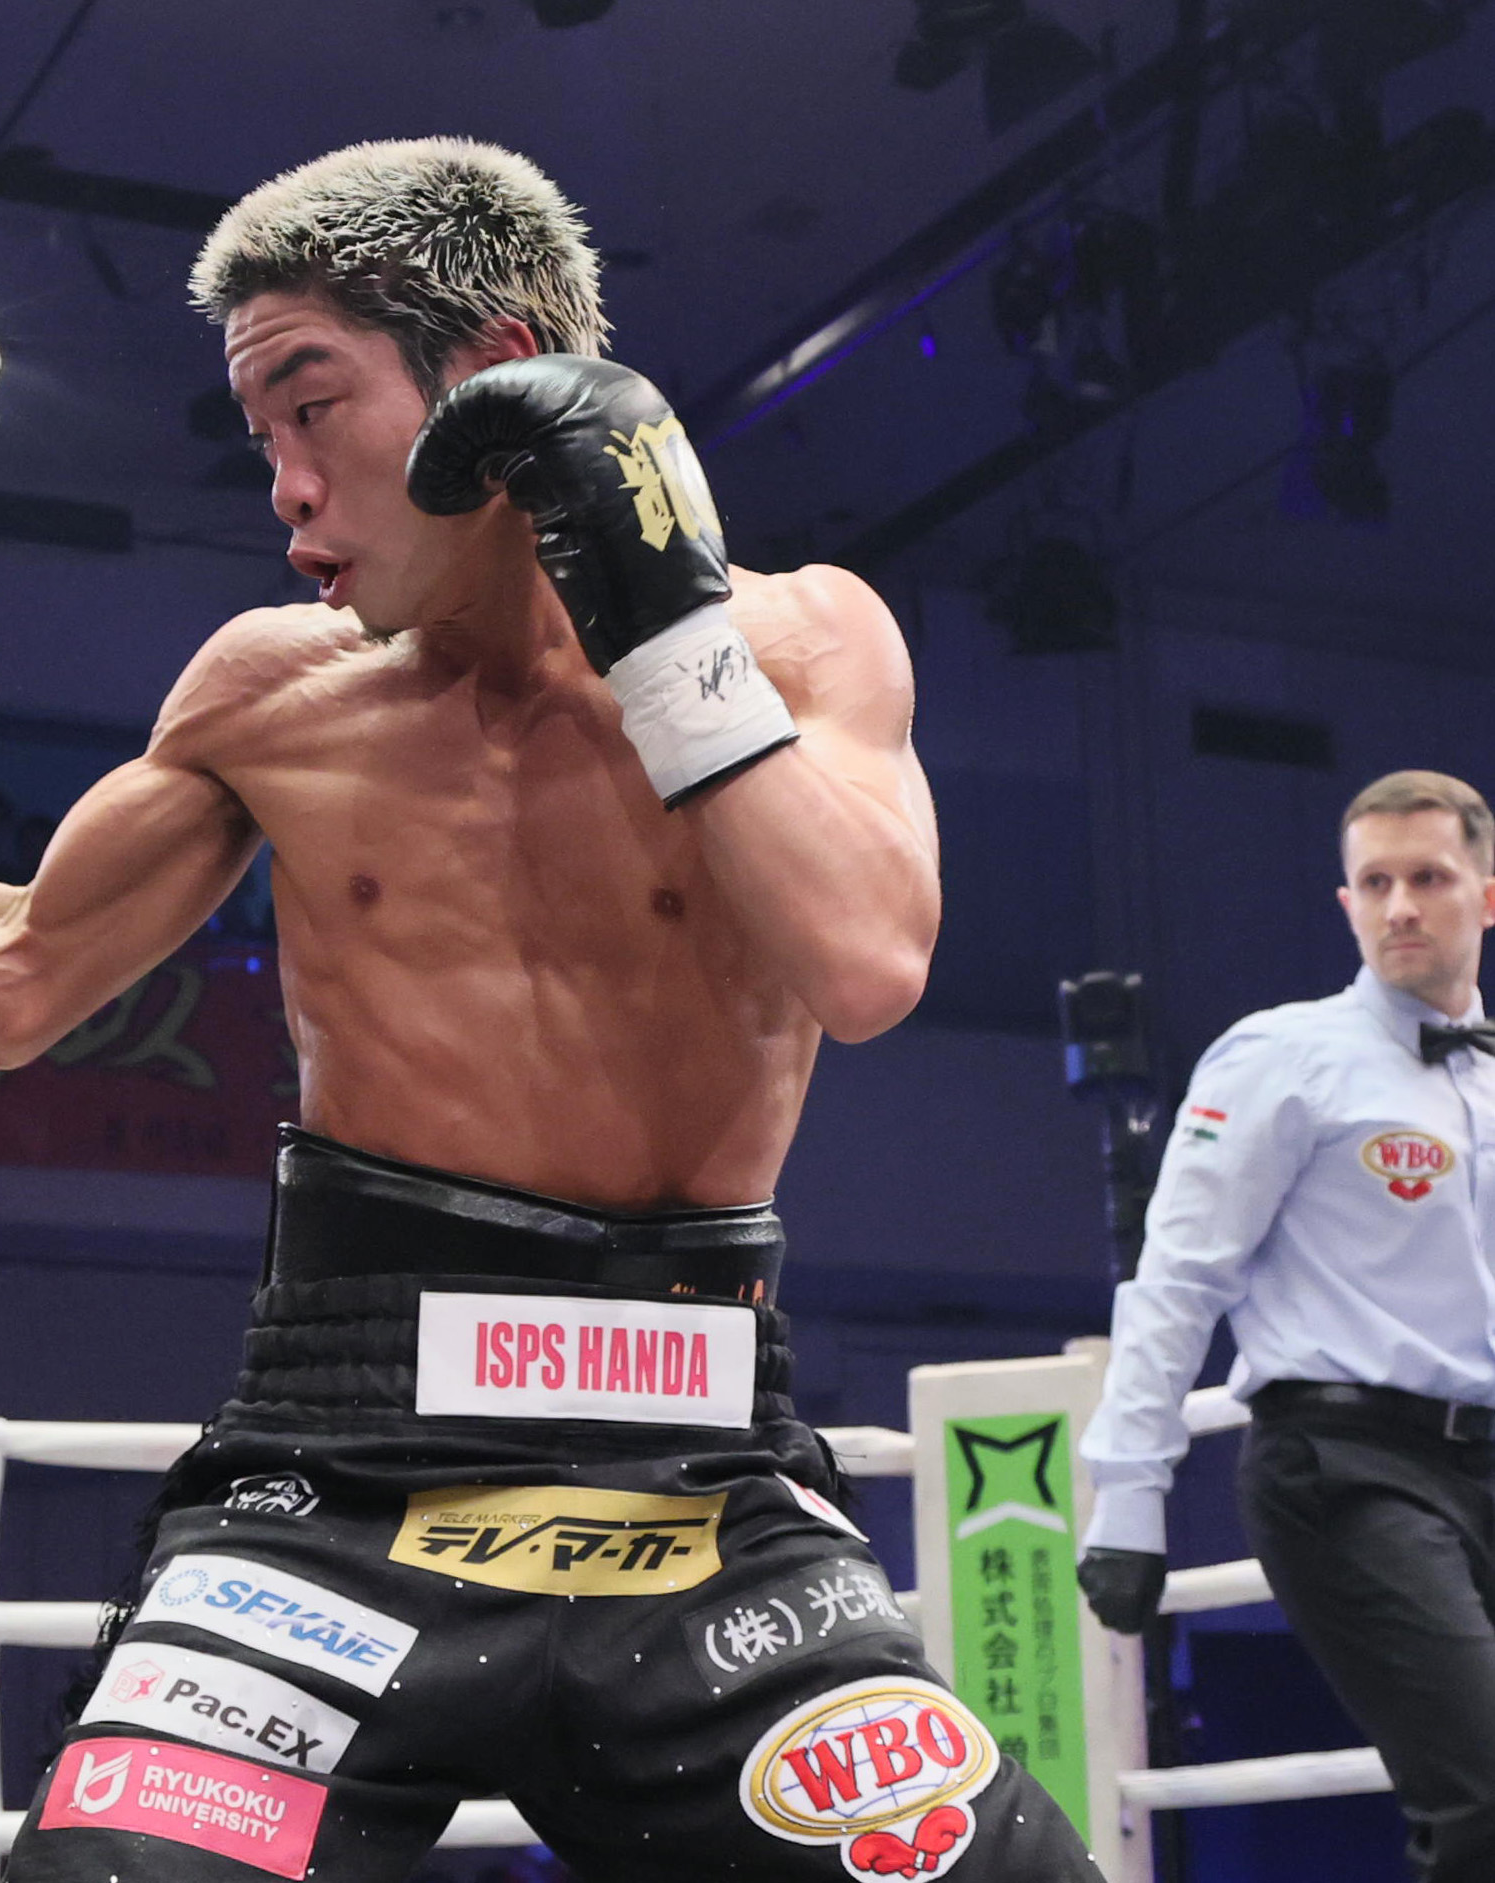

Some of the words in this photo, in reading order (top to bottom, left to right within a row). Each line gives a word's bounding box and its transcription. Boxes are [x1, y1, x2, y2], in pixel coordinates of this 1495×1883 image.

[1377, 1141, 1446, 1170] WBO
[474, 1321, 566, 1391] ISPS
[577, 1325, 709, 1398] HANDA
[163, 1678, 324, 1768] Pac.EX
[142, 1764, 287, 1823] RYUKOKU
[780, 1706, 967, 1813] WBO
[138, 1788, 280, 1844] UNIVERSITY
